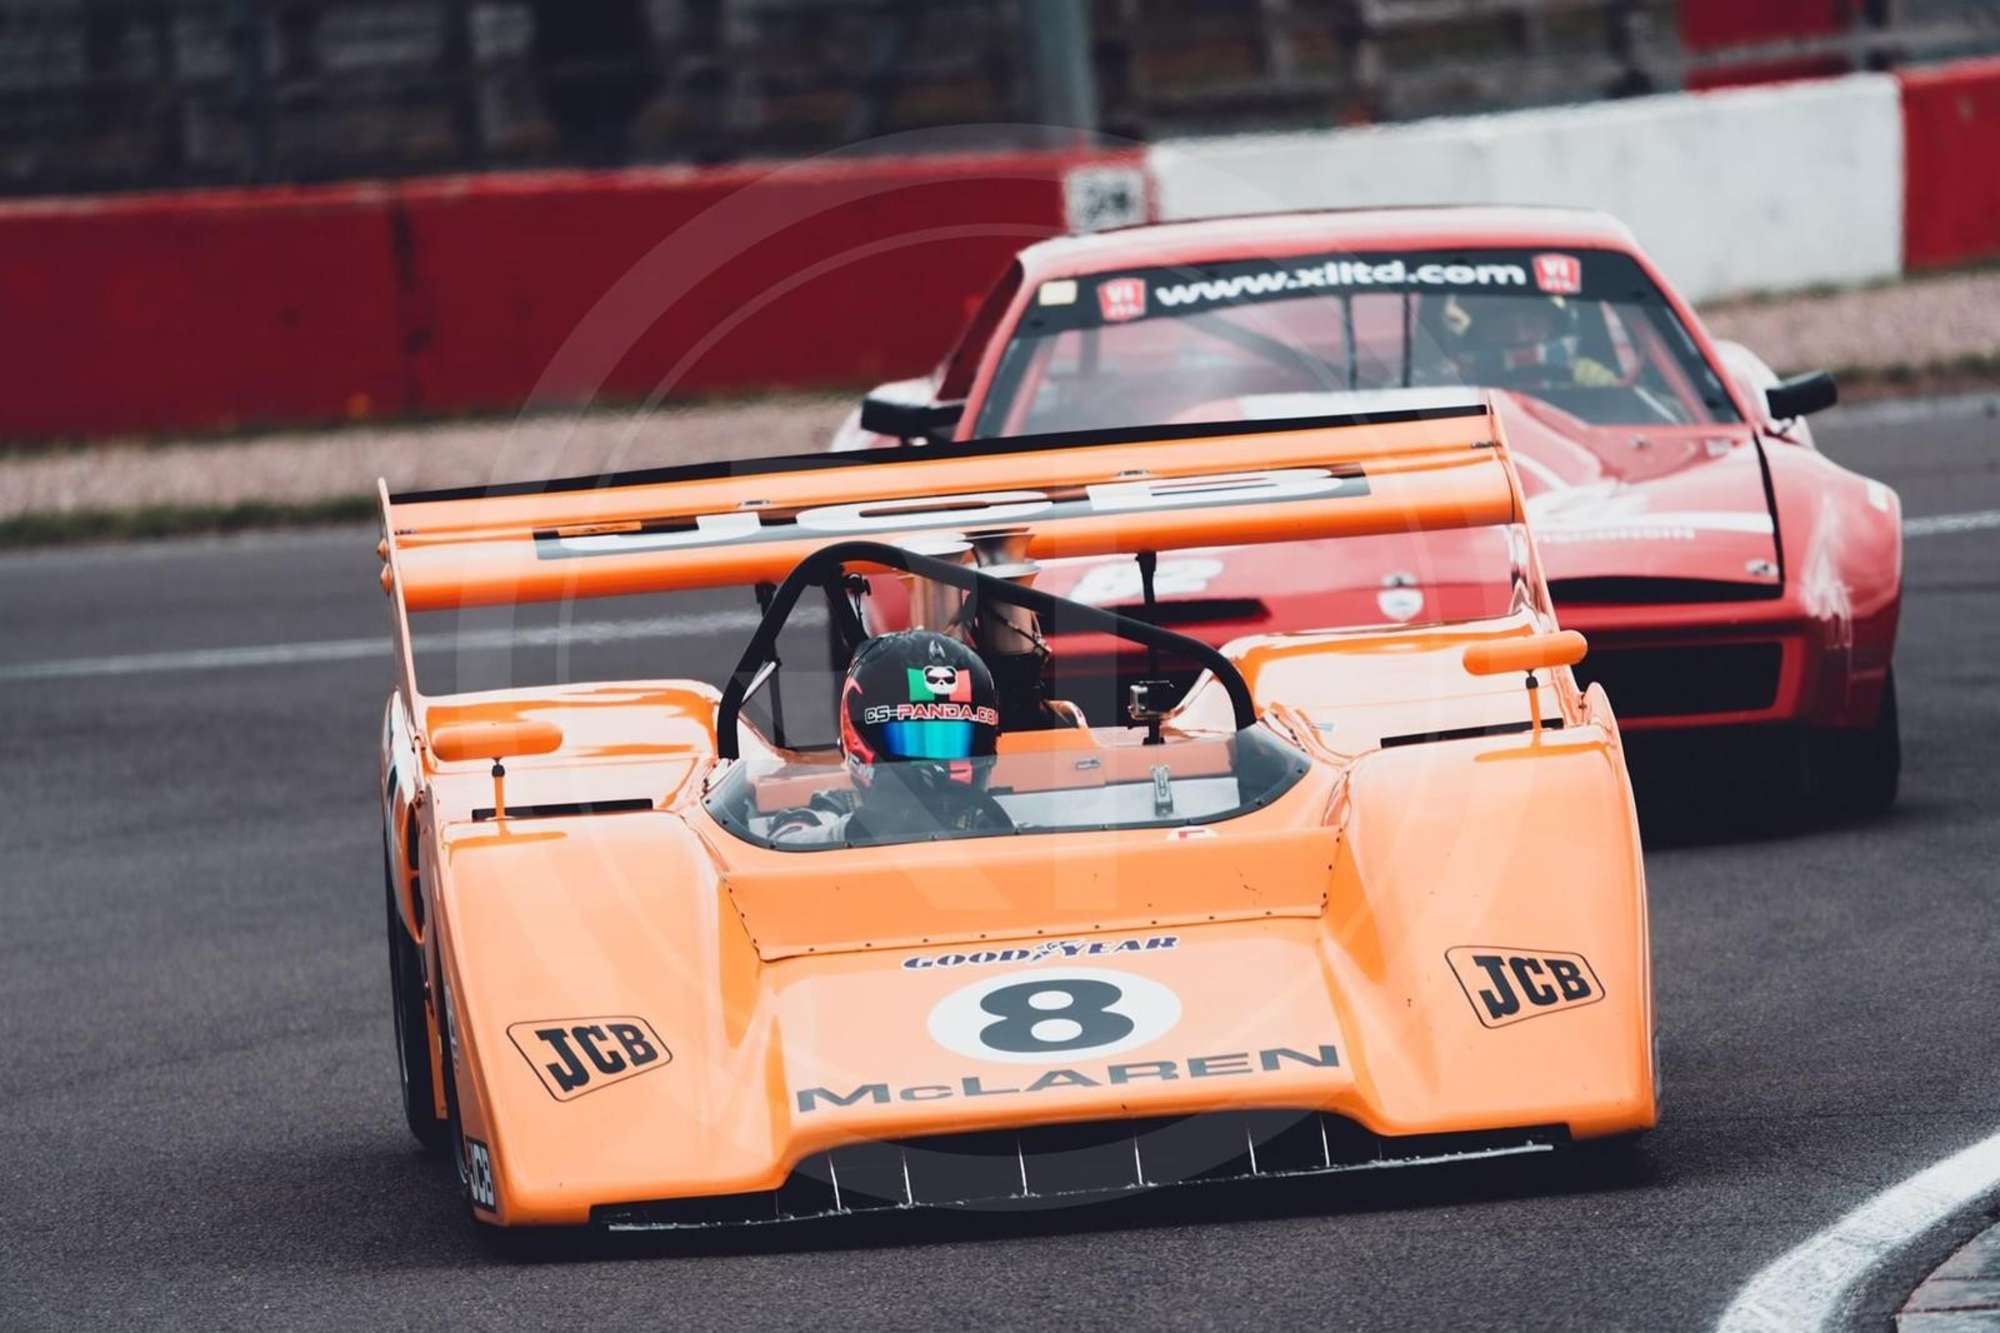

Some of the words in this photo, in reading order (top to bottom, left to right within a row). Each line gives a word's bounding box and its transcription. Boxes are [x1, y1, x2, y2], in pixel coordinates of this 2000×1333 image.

[1156, 259, 1526, 306] www.xlltd.com
[559, 468, 1344, 552] JCB
[901, 936, 1178, 968] GOODYEAR
[979, 978, 1134, 1053] 8
[1472, 954, 1592, 1020] JCB
[535, 1023, 659, 1093] JCB
[797, 1044, 1341, 1112] McLAREN
